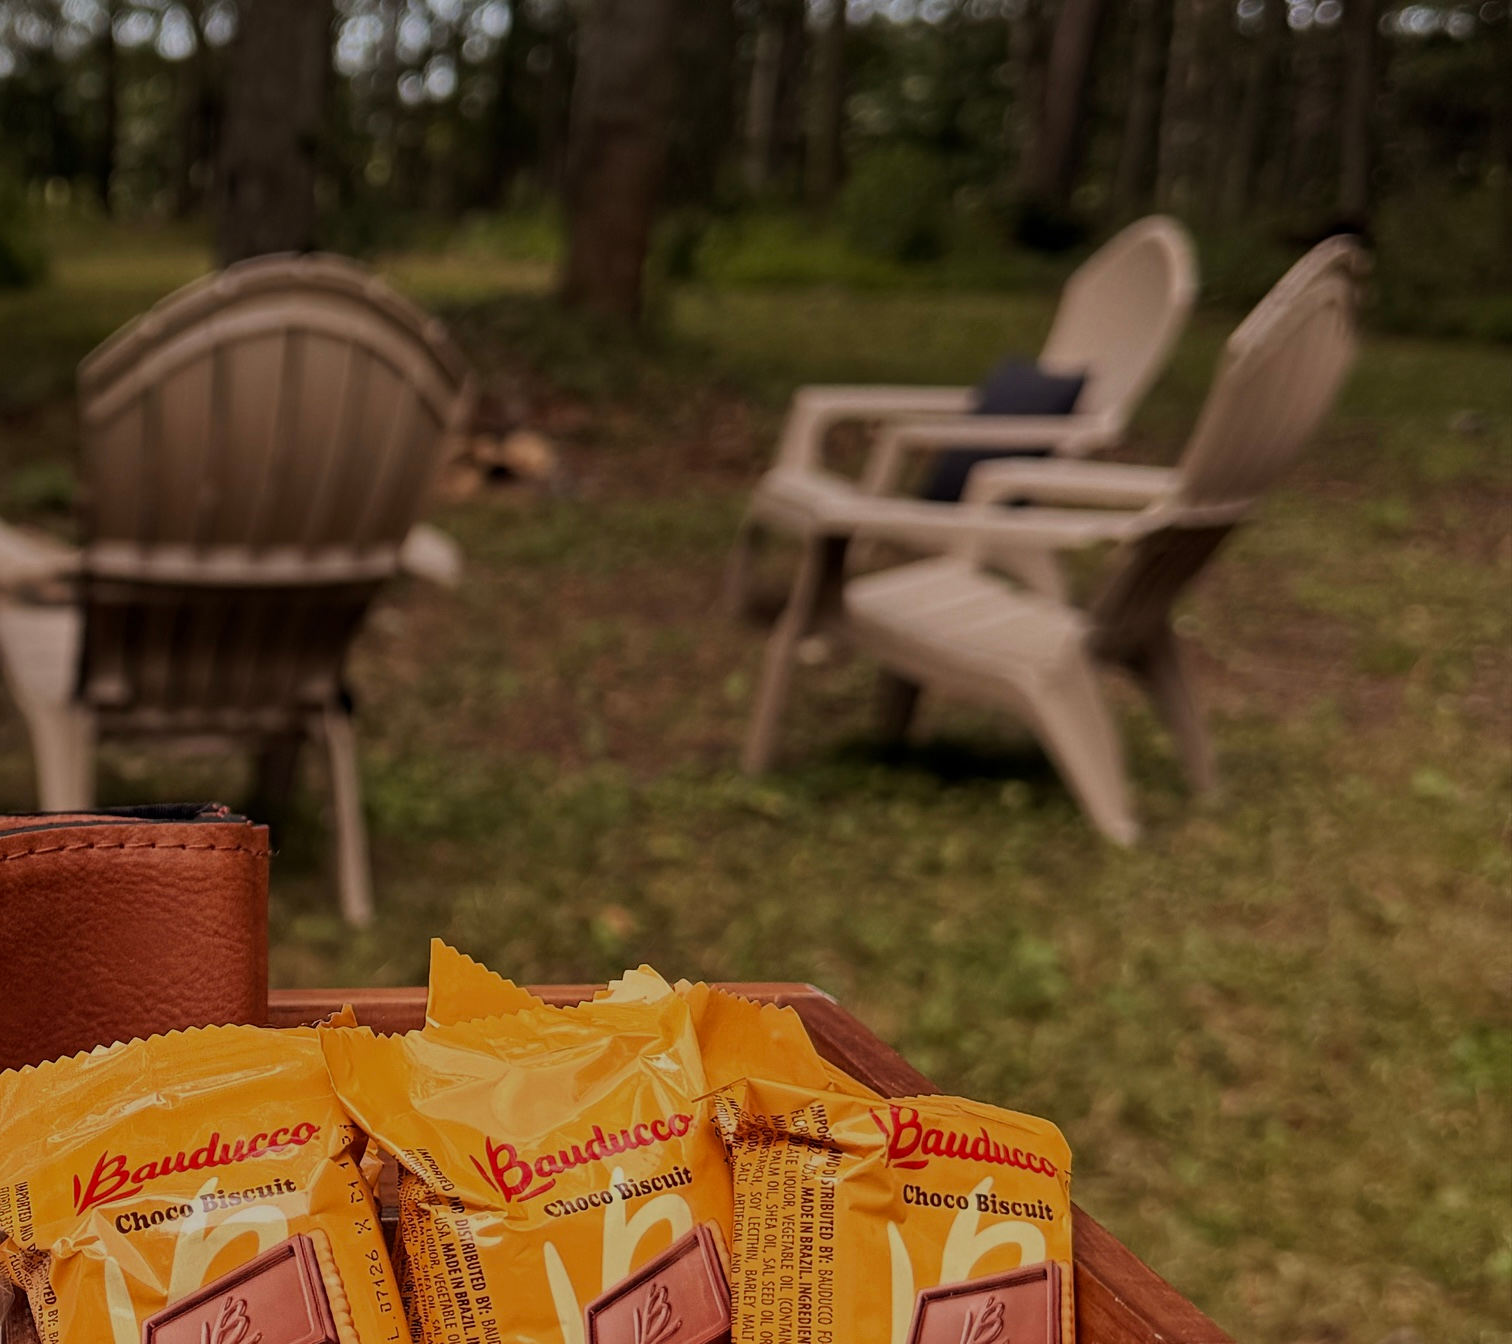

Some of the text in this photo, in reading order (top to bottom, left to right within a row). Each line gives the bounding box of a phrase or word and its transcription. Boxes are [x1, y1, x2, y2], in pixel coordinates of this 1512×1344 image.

[870, 1105, 1056, 1177] Bauducco
[73, 1122, 321, 1216] Bauducco
[469, 1114, 693, 1203] Bauducco
[736, 1162, 752, 1185] SALT,
[767, 1150, 783, 1176] PALM
[115, 1178, 296, 1233] Choco Biscuit
[544, 1166, 693, 1227] Choco Biscuit
[749, 1192, 762, 1211] SOY
[781, 1170, 798, 1210] LIQUOR,
[800, 1187, 815, 1219] MADE
[819, 1170, 837, 1241] DISTRIBUTED
[903, 1184, 1054, 1221] Choco Biscuit
[764, 1204, 779, 1230] SHEA
[799, 1221, 814, 1234] IN
[744, 1216, 760, 1263] LECITHIN,
[762, 1234, 777, 1253] OIL,
[780, 1214, 795, 1271] VEGETABLE
[819, 1246, 834, 1264] BY:
[440, 1243, 462, 1275] MADE
[455, 1219, 487, 1291] DISTRIBUTED
[475, 1295, 493, 1315] BY:
[762, 1258, 776, 1276] SAL
[799, 1236, 814, 1280] BRAZIL.
[433, 1272, 458, 1328] VEGETABLE
[450, 1277, 466, 1290] IN
[743, 1269, 758, 1308] BARLEY
[761, 1281, 775, 1306] SEED
[779, 1275, 794, 1292] OIL
[817, 1269, 834, 1325] BAUDUCCO
[455, 1291, 476, 1335] BRAZIL.
[741, 1313, 755, 1341] MALT
[759, 1310, 774, 1326] OIL
[759, 1331, 773, 1344] OR
